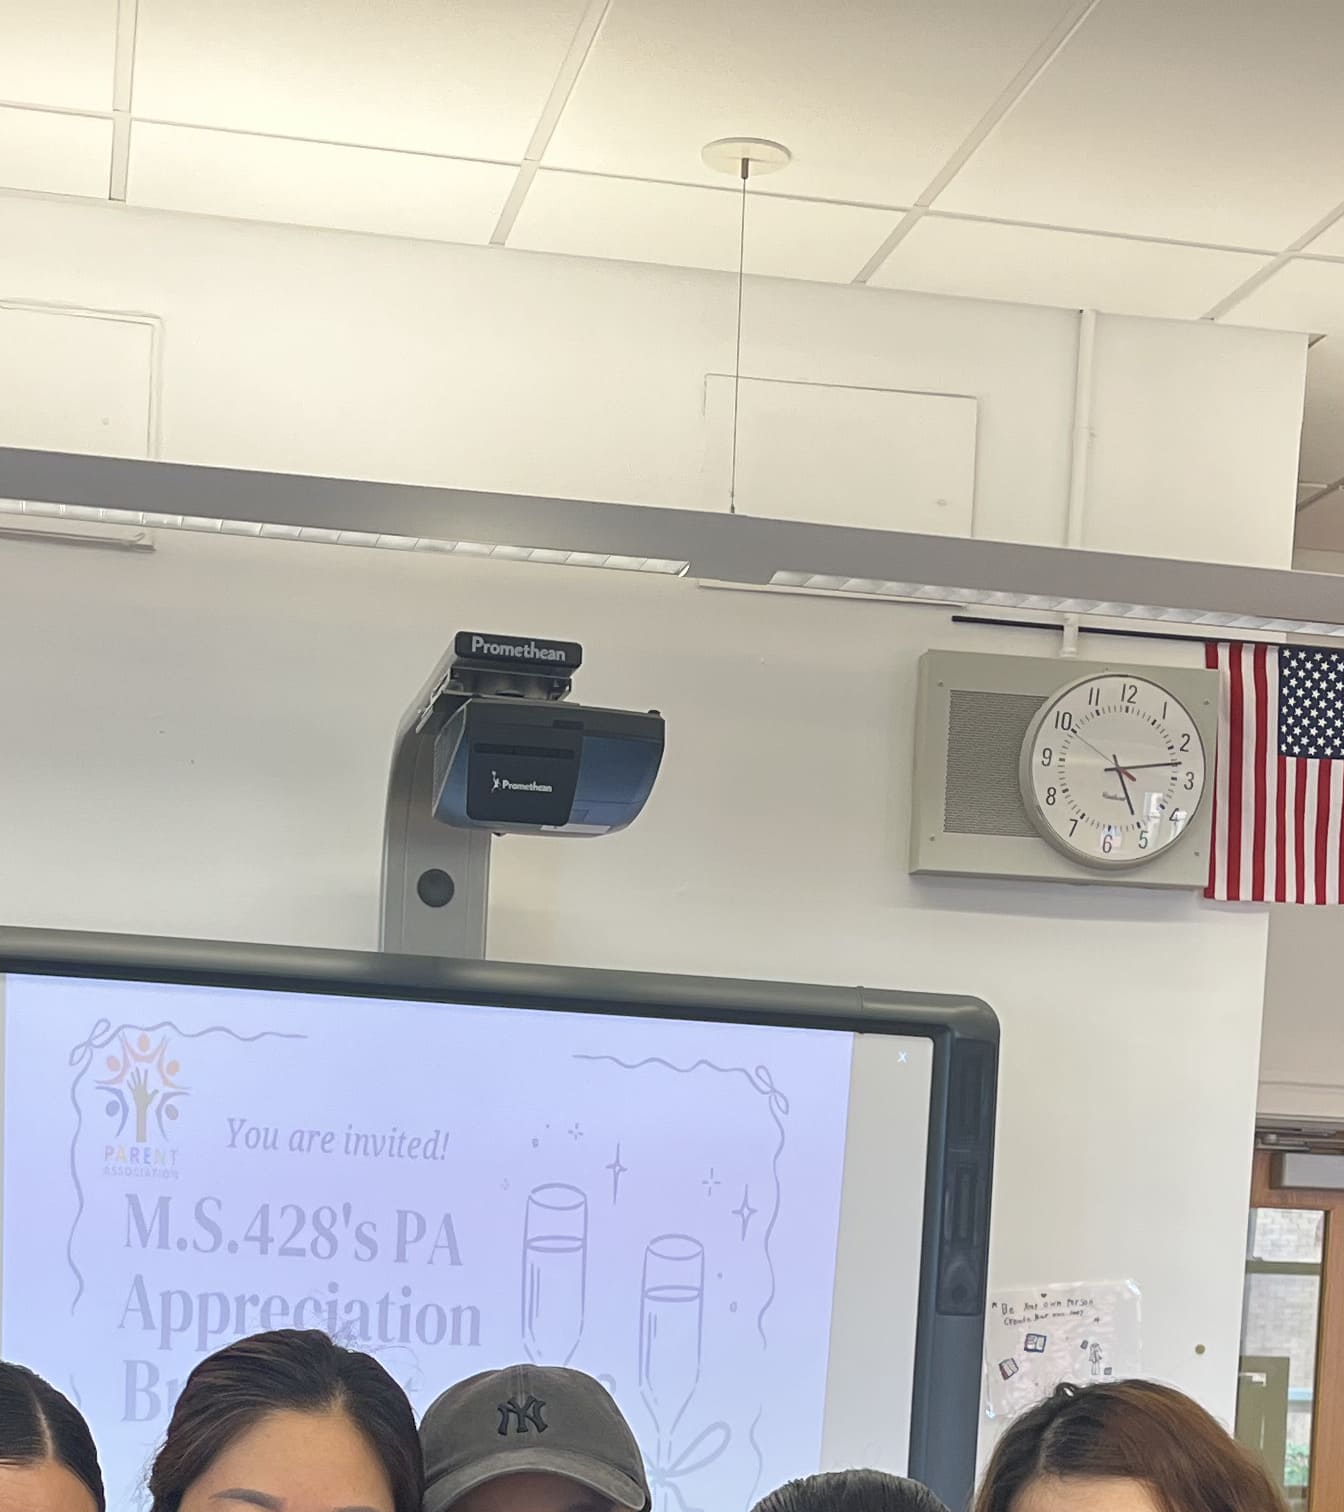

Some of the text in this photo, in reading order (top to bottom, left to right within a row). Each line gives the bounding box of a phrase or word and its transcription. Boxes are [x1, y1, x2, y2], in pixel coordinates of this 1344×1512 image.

[471, 635, 566, 661] Promethean
[1088, 686, 1101, 707] 11
[1121, 683, 1138, 705] 12
[1161, 701, 1169, 720] 1
[1054, 711, 1072, 731] 10
[1180, 732, 1192, 753] 2
[1041, 747, 1053, 767] 9
[502, 779, 553, 793] Promethean
[1184, 771, 1195, 790] 3
[1046, 786, 1057, 805] 8
[1169, 807, 1181, 824] 4
[1068, 818, 1079, 838] 7
[1102, 834, 1113, 854] 6
[1138, 830, 1150, 850] 5
[226, 1118, 450, 1161] You are invited!
[104, 1145, 178, 1166] PARENT
[123, 1193, 464, 1267] M.S.428's PA
[117, 1273, 483, 1352] Appreciation
[497, 1395, 548, 1436] NY
